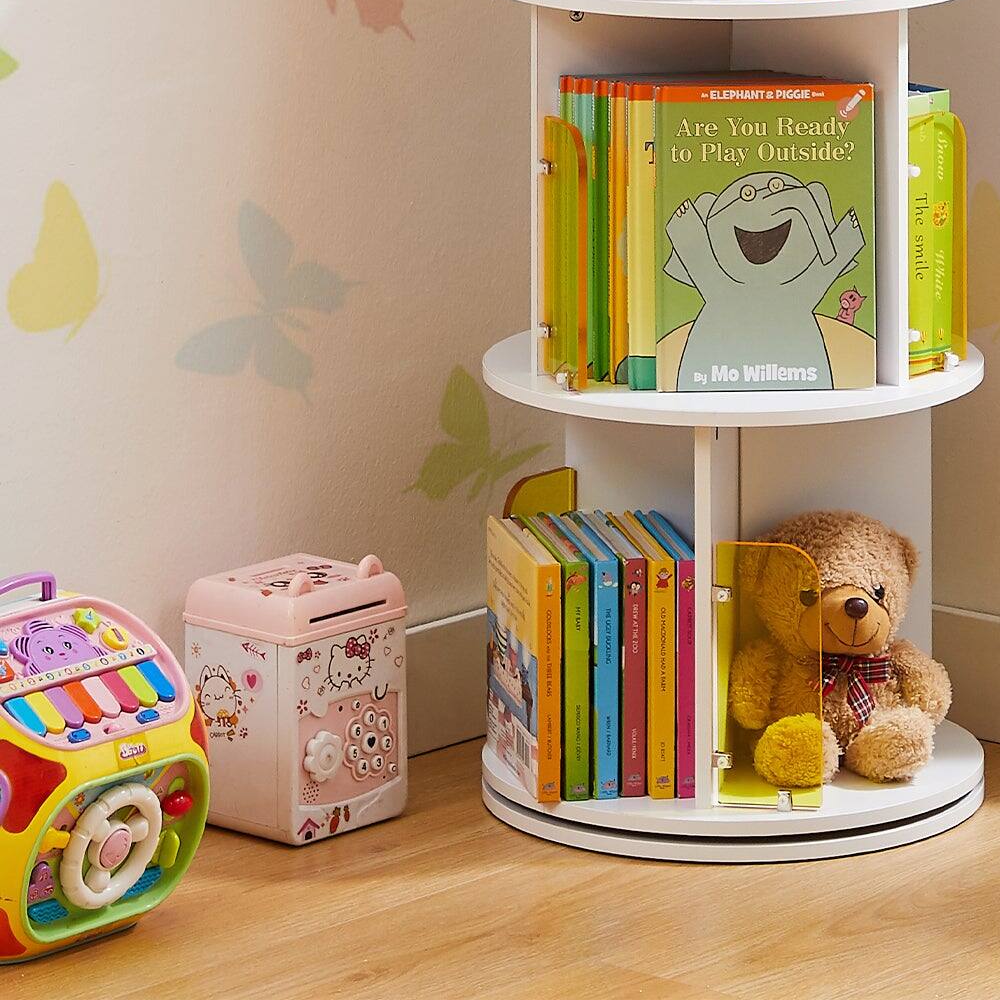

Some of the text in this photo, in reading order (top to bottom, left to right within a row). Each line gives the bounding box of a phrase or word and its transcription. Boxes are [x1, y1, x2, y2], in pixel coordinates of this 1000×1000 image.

[709, 89, 766, 100] ELEPHANT
[775, 89, 811, 100] PIGGIE
[675, 116, 851, 141] Are You Ready
[670, 145, 693, 163] to
[701, 142, 750, 167] Play
[757, 141, 856, 163] Outside?
[934, 131, 948, 301] Snow White
[914, 193, 929, 280] The smile
[693, 363, 819, 386] By Mo Willems
[369, 713, 375, 723] 0
[383, 719, 388, 729] 1
[355, 726, 361, 737] 6
[384, 738, 391, 747] 2
[352, 748, 358, 759] 5
[361, 762, 367, 772] 4
[376, 757, 382, 768] 3
